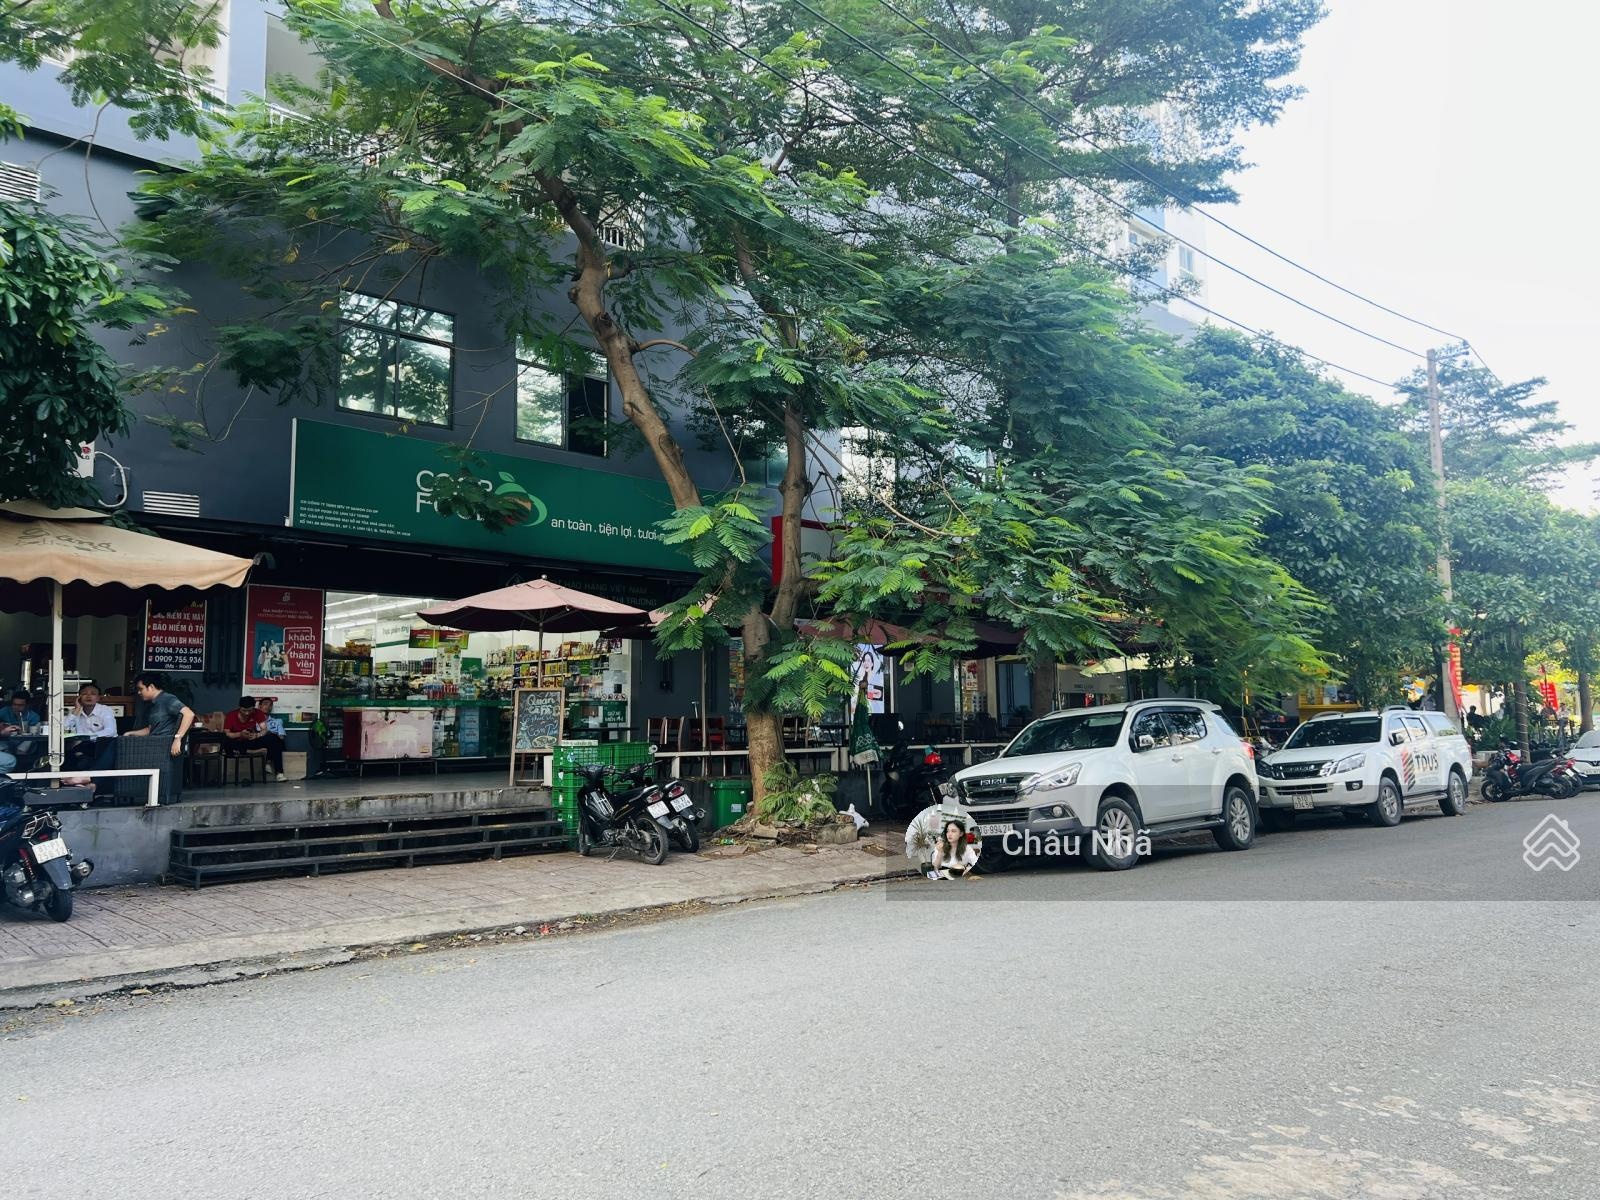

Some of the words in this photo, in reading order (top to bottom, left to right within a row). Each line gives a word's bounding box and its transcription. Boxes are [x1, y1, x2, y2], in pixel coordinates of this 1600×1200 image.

[551, 519, 565, 528] an
[568, 520, 592, 532] toàn
[598, 522, 618, 536] tiện
[620, 525, 632, 538] lợi
[294, 642, 316, 652] hàng
[290, 651, 315, 660] thành
[296, 660, 314, 668] viên
